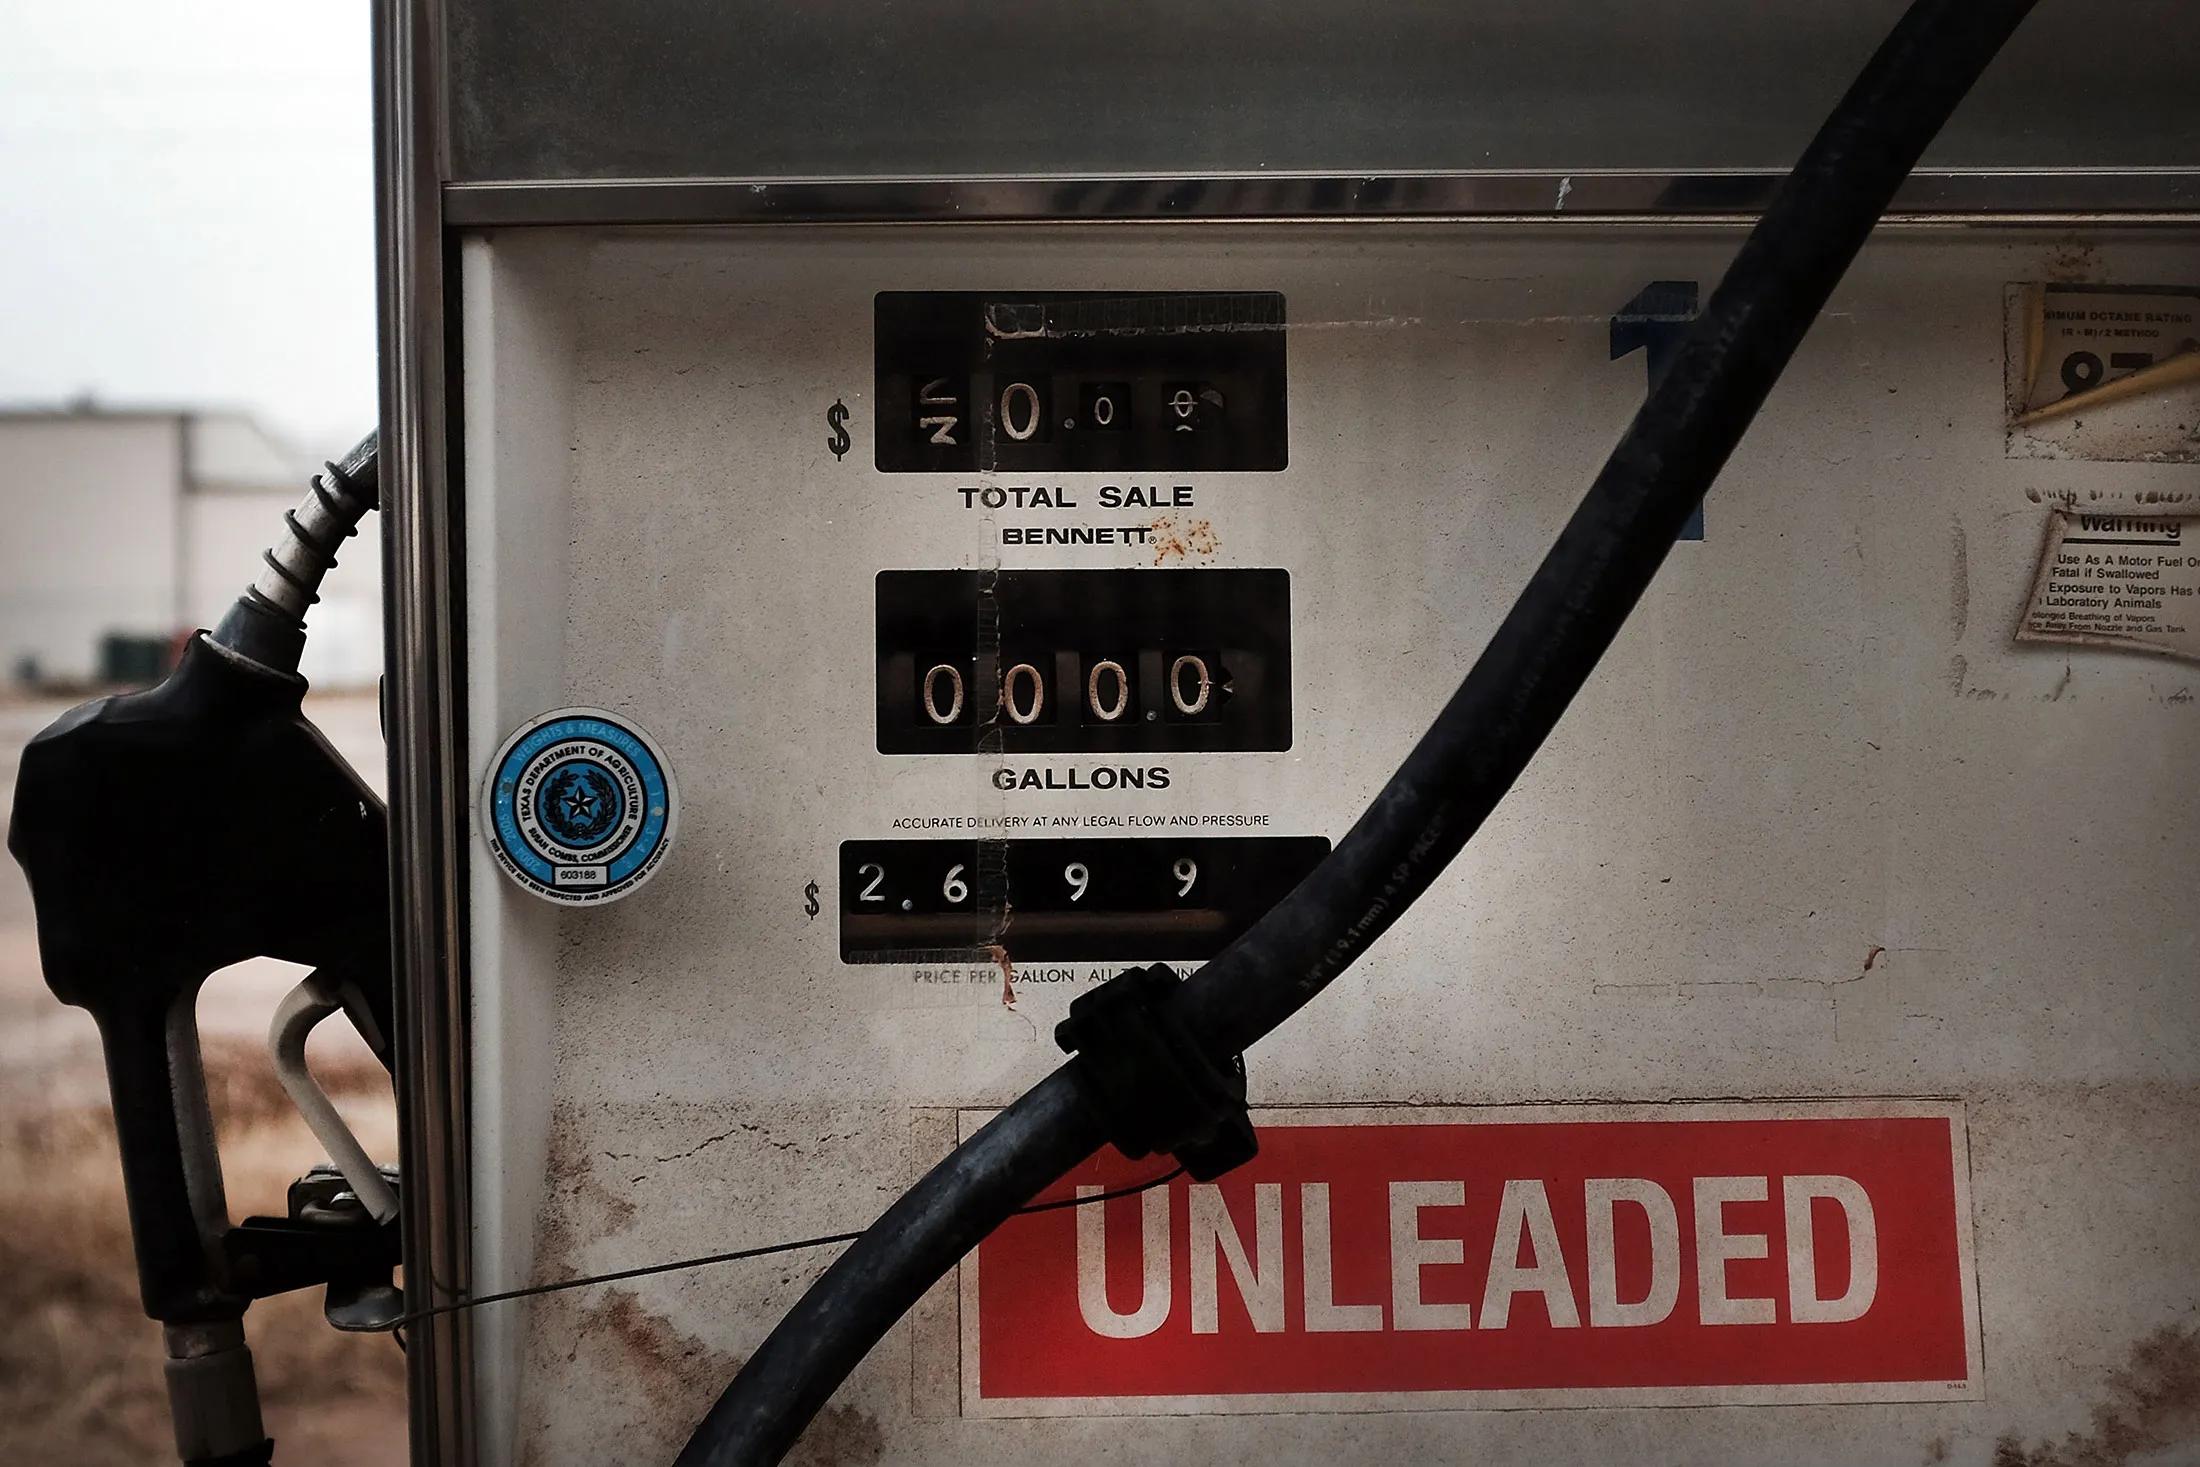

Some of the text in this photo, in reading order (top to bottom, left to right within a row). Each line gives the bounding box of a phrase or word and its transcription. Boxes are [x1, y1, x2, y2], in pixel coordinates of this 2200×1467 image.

[2089, 312, 2141, 323] OCTANE
[2146, 313, 2193, 324] RATING
[2114, 328, 2160, 338] METHOD
[827, 398, 850, 461] $
[957, 486, 1195, 509] TOTAL SALE
[2080, 515, 2181, 539] Warning
[2057, 554, 2080, 565] Use
[2085, 554, 2100, 565] As
[2104, 555, 2114, 565] A
[2118, 556, 2153, 566] Motor
[2157, 556, 2183, 567] Fuel
[2052, 567, 2160, 580] Fatal if Swallowed
[2049, 582, 2104, 595] Exposure
[2109, 584, 2121, 594] to
[2126, 584, 2166, 597] Vapors
[2171, 585, 2193, 596] Has
[2046, 596, 2109, 610] Laboratory
[2114, 598, 2162, 609] Animals
[2069, 612, 2110, 623] Breathing
[2114, 613, 2122, 621] of
[2126, 614, 2156, 623] Vapors
[2045, 621, 2067, 631] Away
[2069, 622, 2091, 631] From
[2094, 623, 2123, 632] Nozzle
[2125, 624, 2142, 632] and
[2145, 625, 2163, 633] Gas
[2166, 625, 2186, 633] Tank
[512, 723, 561, 761] WEIGHTS
[579, 723, 642, 758] MEASURES
[520, 745, 639, 822] TEXAS DEPARTMENT OF AGRICULTURE
[991, 766, 1171, 790] GALLONS
[892, 814, 1270, 829] ACCURATE DELIVERY AT ANY LEGAL FLOW AND PRESSURE
[528, 827, 549, 851] SUSAN
[581, 824, 634, 863] COMMISSIONER
[490, 838, 501, 853] THIS
[498, 851, 516, 874] DEVICE
[516, 871, 529, 882] HAS
[528, 881, 545, 894] BEEN
[546, 889, 582, 901] INSPECTED
[584, 893, 600, 901] AND
[601, 880, 634, 898] APPROVED
[634, 871, 647, 884] FOR
[646, 838, 671, 872] ACCURACY
[560, 869, 597, 880] 603188
[804, 879, 820, 920] $
[913, 969, 965, 984] PRICE
[969, 969, 998, 983] PER
[1010, 968, 1075, 984] GALLON
[1074, 1173, 1879, 1340] UNLEADED
